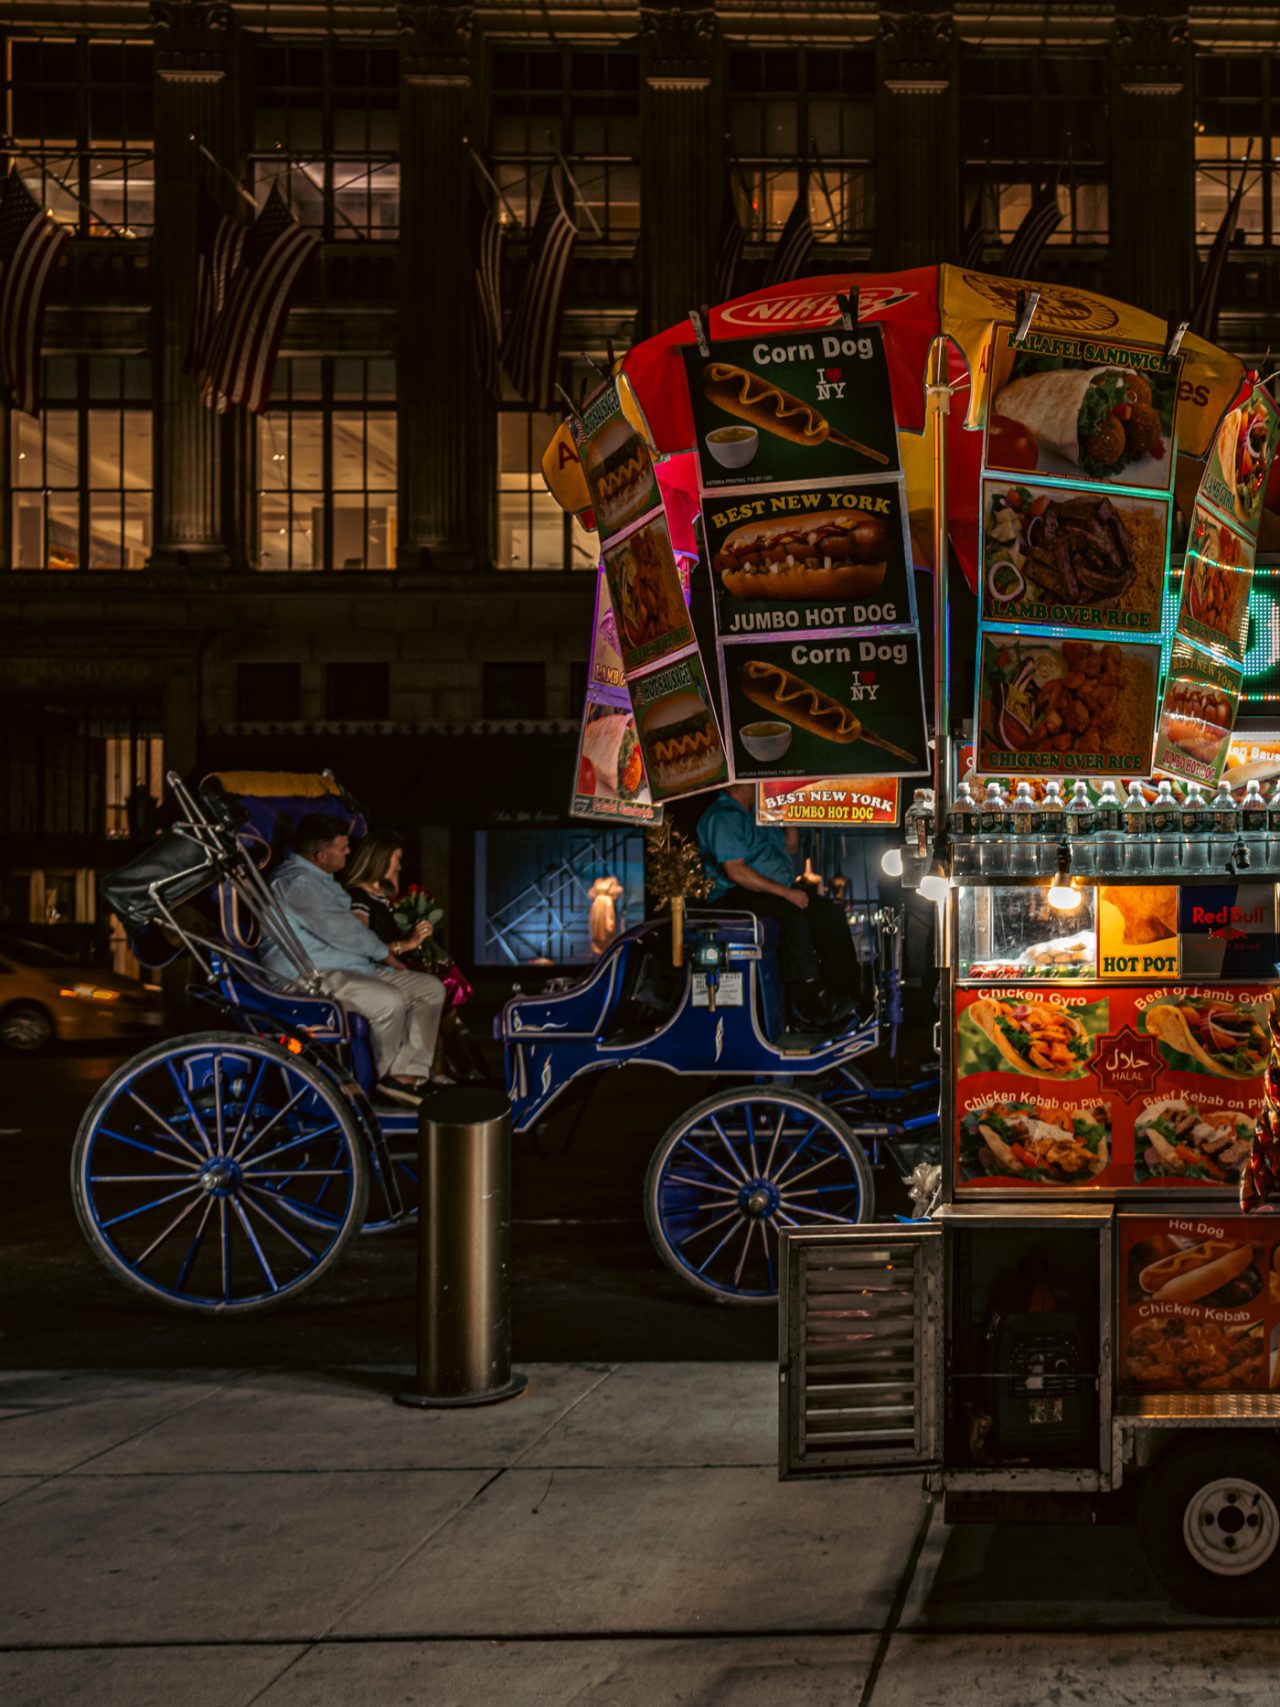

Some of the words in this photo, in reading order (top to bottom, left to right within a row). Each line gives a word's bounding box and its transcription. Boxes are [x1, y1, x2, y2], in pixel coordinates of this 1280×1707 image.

[752, 341, 814, 365] Corn
[822, 336, 874, 360] Dog
[1008, 332, 1083, 359] FALAFEL
[1085, 343, 1171, 374] SANDWICH
[816, 368, 827, 384] I
[816, 382, 846, 400] NY
[712, 500, 766, 529] BEST
[770, 493, 822, 512] NEW
[827, 493, 892, 514] YORK
[730, 610, 799, 632] JUMBO
[806, 607, 847, 626] HOT
[854, 603, 897, 623] DOG
[991, 600, 1047, 620] LAMB
[1052, 605, 1102, 623] OVER
[1107, 609, 1150, 627] RICE
[791, 645, 850, 665] Corn
[859, 642, 908, 664] Dog
[594, 663, 619, 686] LAMB
[852, 671, 861, 685] I
[1173, 659, 1194, 670] BEST
[1196, 662, 1217, 677] NEW
[850, 685, 879, 700] NY
[988, 751, 1059, 769] CHICKEN
[1063, 753, 1108, 770] OVER
[1110, 755, 1142, 770] RICE
[1186, 759, 1200, 774] HOT
[765, 793, 806, 810] BEST
[810, 791, 848, 801] NEW
[852, 793, 894, 812] YORK
[788, 805, 826, 819] JUMBO
[827, 806, 850, 819] HOT
[852, 806, 874, 820] DOG
[1191, 905, 1228, 925] Red
[1230, 906, 1264, 924] Bull
[1104, 957, 1140, 972] HOT
[1144, 957, 1177, 972] POT
[977, 987, 1044, 1004] Chicken
[1049, 993, 1087, 1009] Gyro
[1134, 987, 1168, 1011] Beef
[1173, 987, 1189, 997] or
[1194, 986, 1234, 1003] Lamb
[1238, 991, 1273, 1006] Gyro
[1105, 1048, 1149, 1072] حلال
[1112, 1072, 1144, 1082] HALAL
[964, 1091, 1016, 1112] Chicken
[1020, 1093, 1060, 1110] Kebab
[1062, 1100, 1079, 1111] on
[1080, 1096, 1104, 1111] Pita
[1143, 1091, 1176, 1108] Beef
[1179, 1090, 1224, 1107] Kebab
[1228, 1098, 1245, 1109] on
[1169, 1219, 1193, 1232] Hot
[1197, 1223, 1224, 1239] Dog
[1139, 1302, 1200, 1317] Chicken
[1204, 1308, 1250, 1322] Kebab
